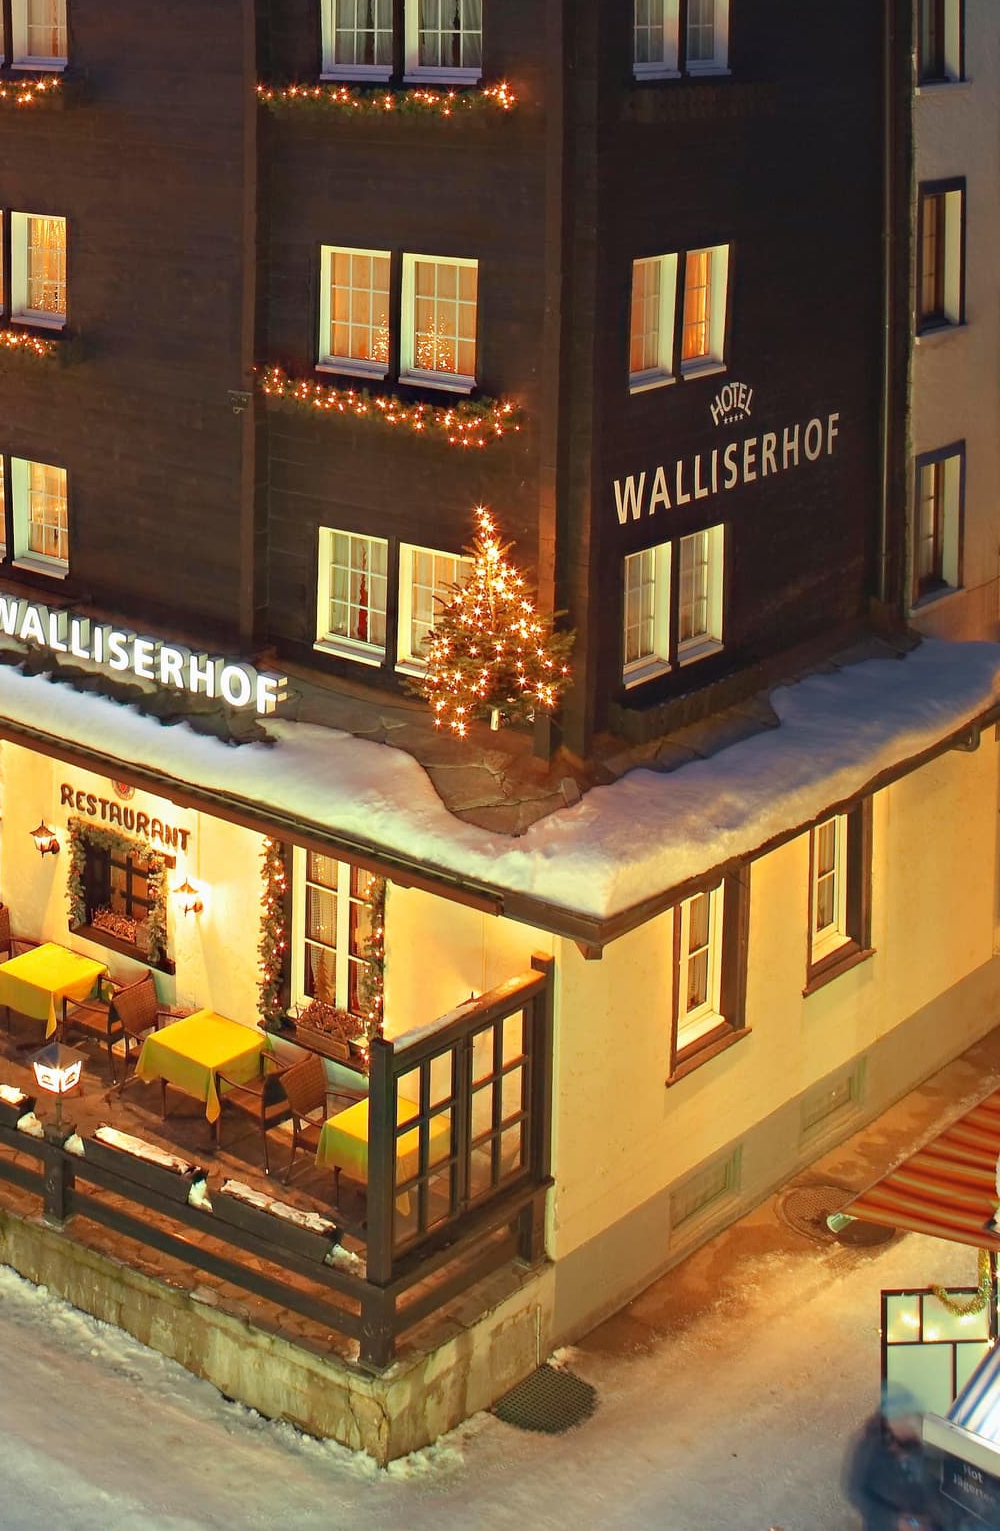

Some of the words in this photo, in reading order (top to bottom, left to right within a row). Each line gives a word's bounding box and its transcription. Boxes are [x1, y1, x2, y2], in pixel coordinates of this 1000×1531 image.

[710, 381, 753, 426] HOTEL
[613, 412, 840, 525] WALLISERHOF
[60, 783, 190, 851] RESTAURANT
